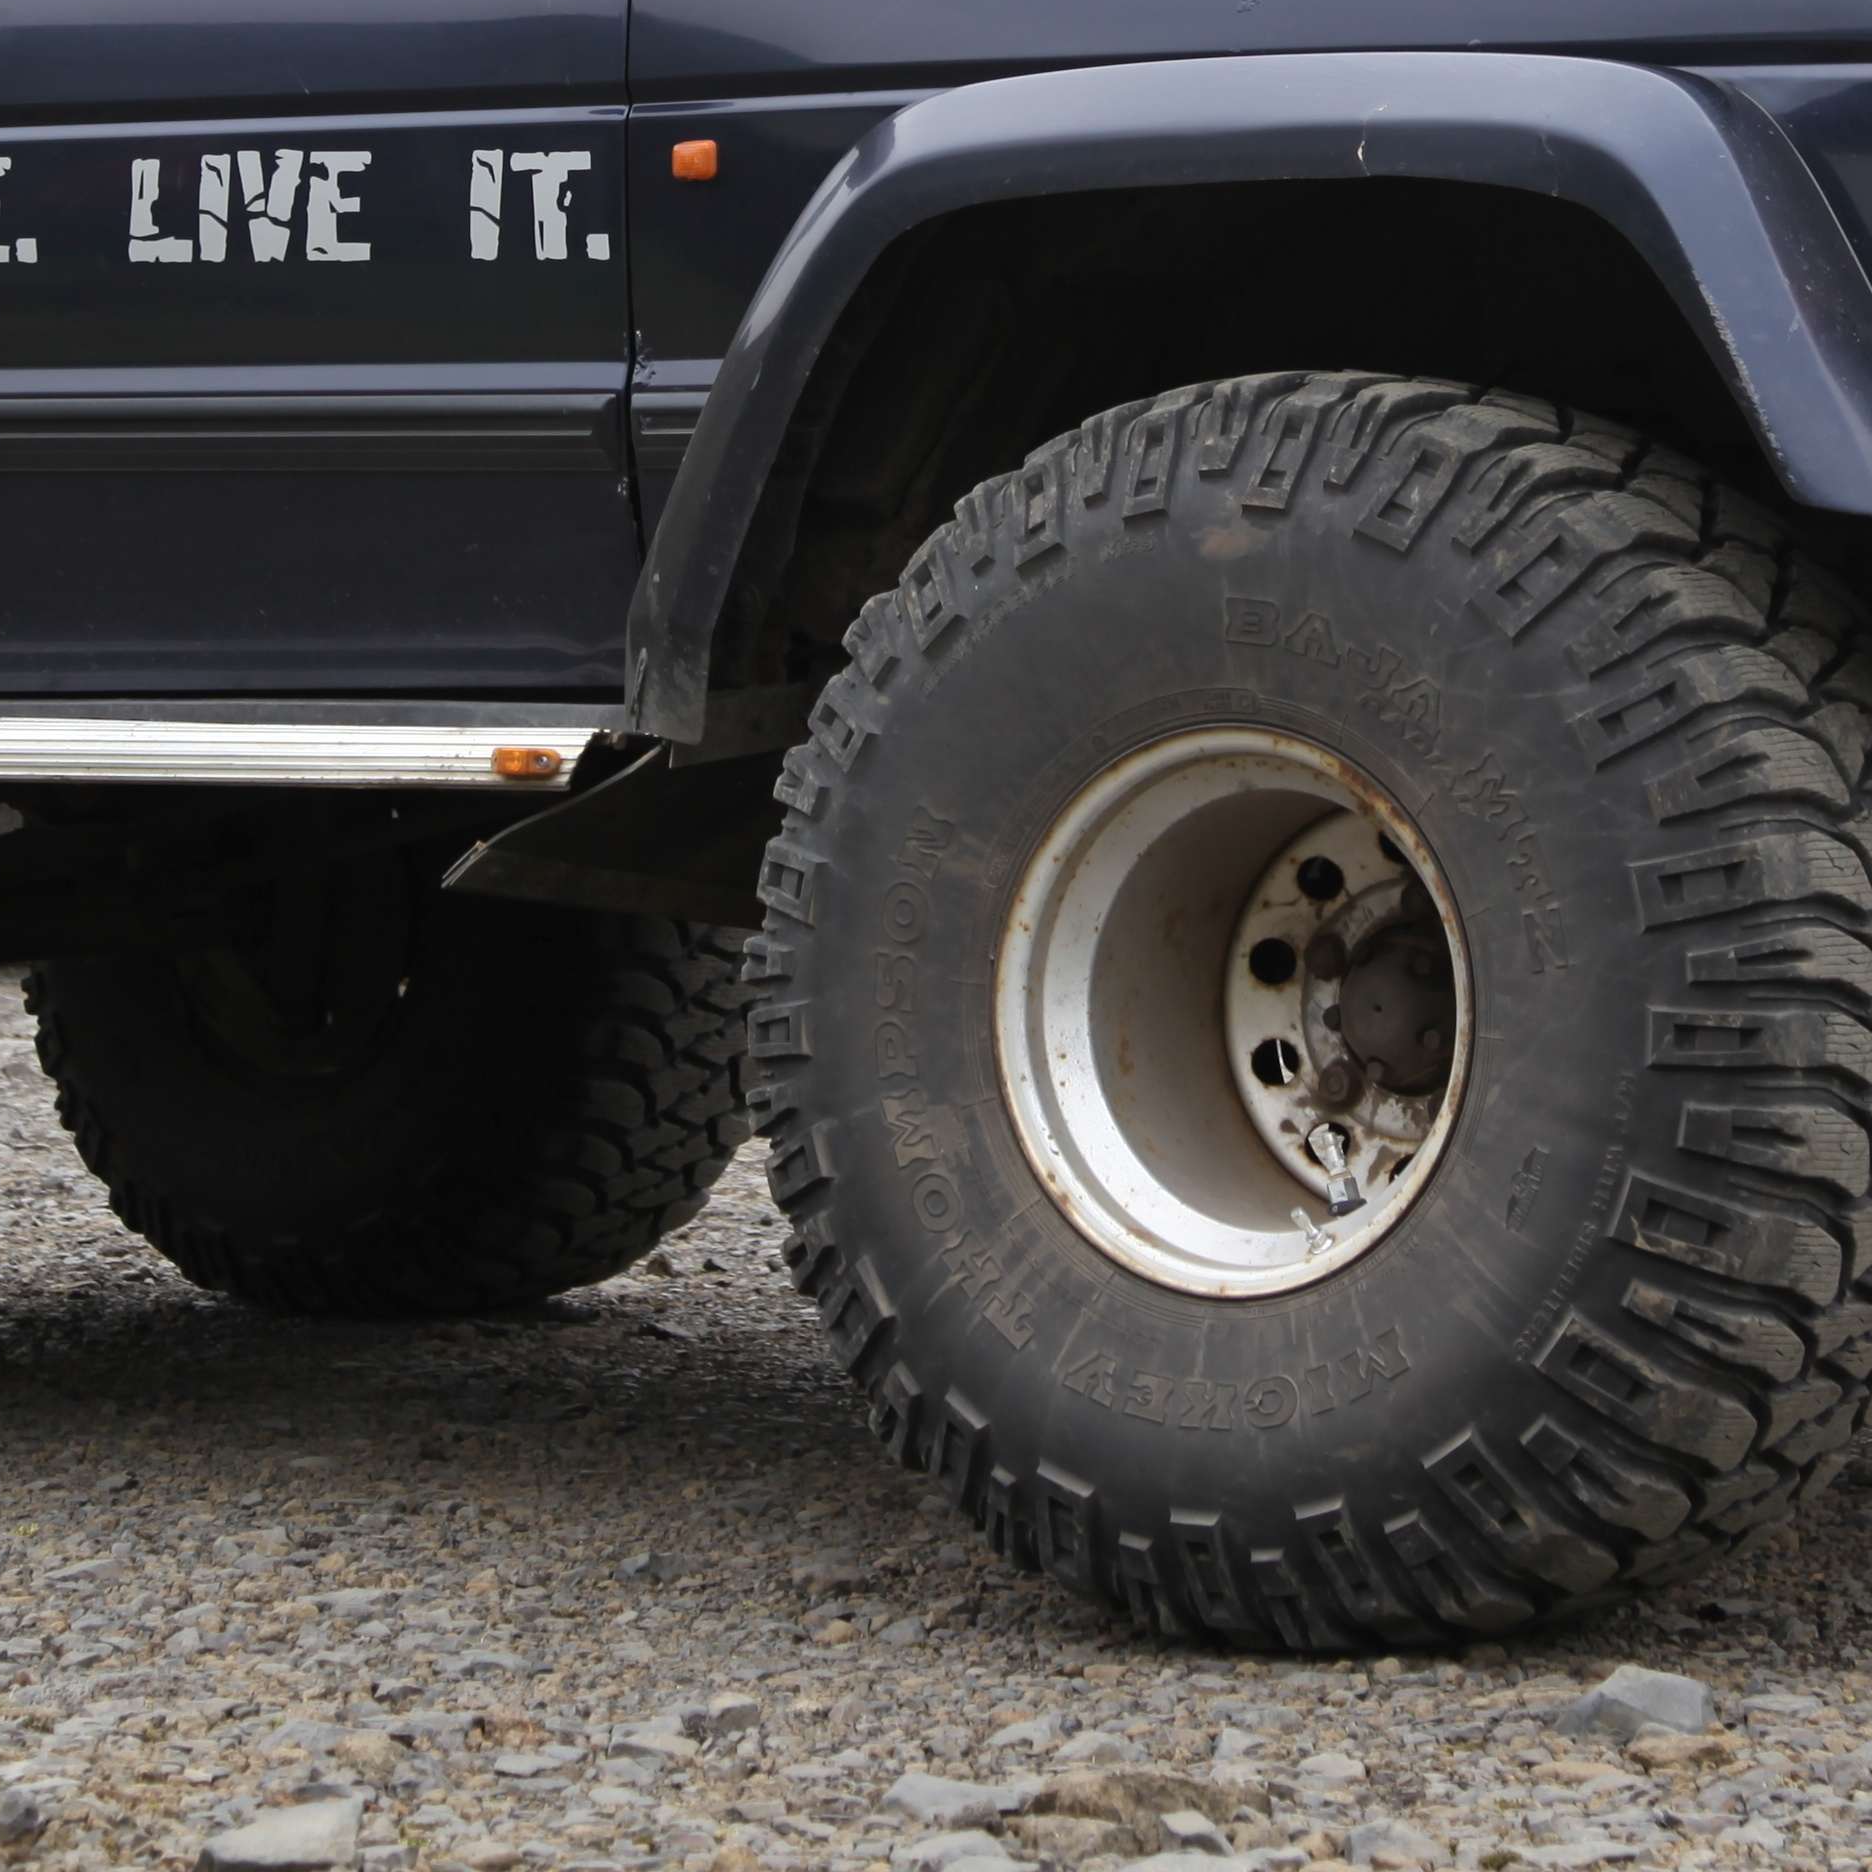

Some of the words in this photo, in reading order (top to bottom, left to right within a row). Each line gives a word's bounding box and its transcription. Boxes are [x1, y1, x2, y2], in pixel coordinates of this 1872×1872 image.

[128, 149, 371, 262] LIVE
[469, 149, 610, 260] IT.
[874, 805, 1035, 1350] THOMPSON
[1062, 1326, 1411, 1432] MICKEY
